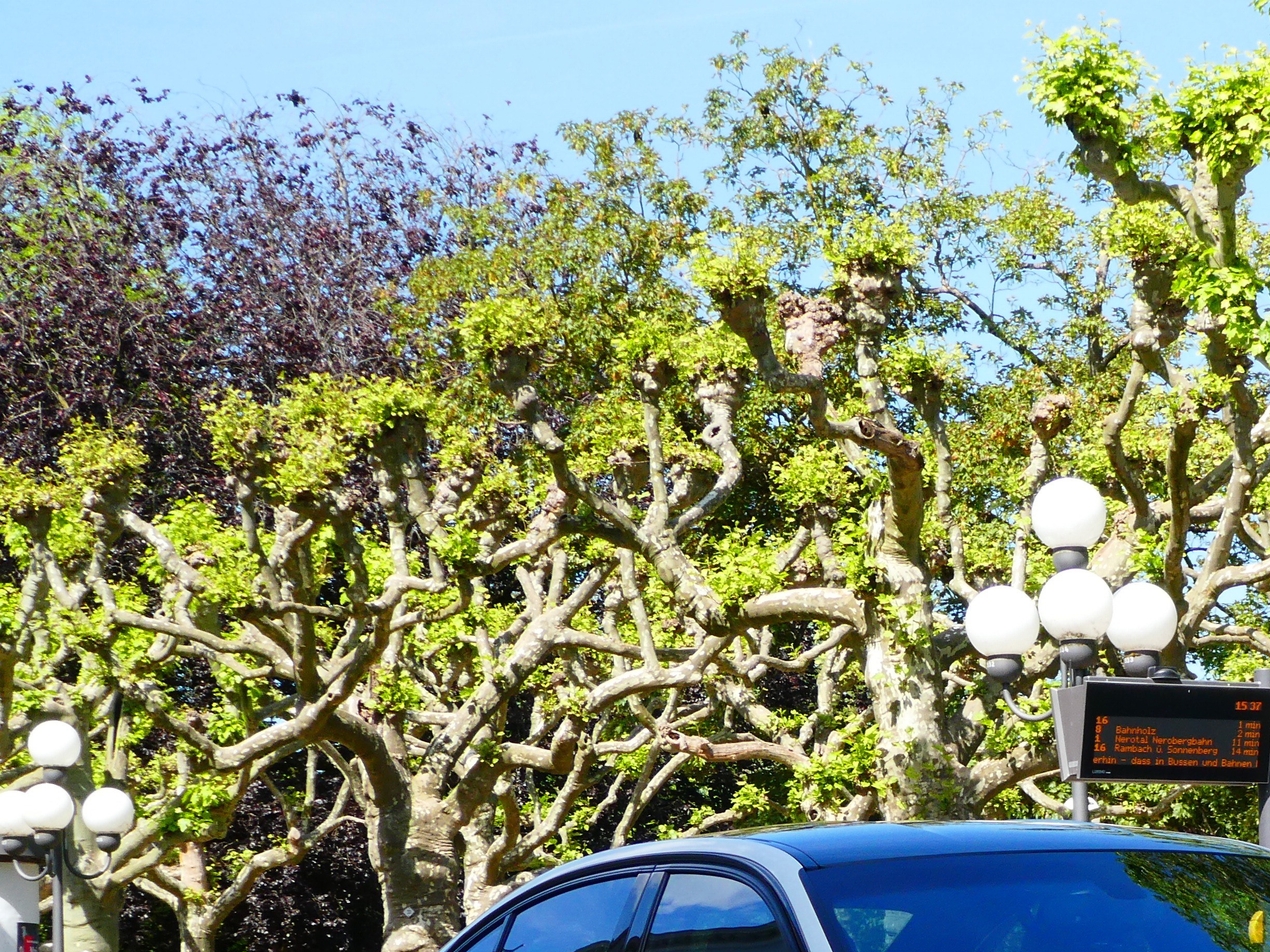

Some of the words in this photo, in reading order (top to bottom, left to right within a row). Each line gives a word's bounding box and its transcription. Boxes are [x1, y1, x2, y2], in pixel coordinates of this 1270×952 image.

[1096, 716, 1109, 725] 16
[1238, 721, 1243, 729] 1
[1245, 721, 1261, 729] min
[1095, 725, 1102, 733] 8
[1115, 725, 1157, 735] Bahnholz
[1237, 730, 1243, 738] 2
[1244, 730, 1260, 738] min
[1094, 734, 1101, 743] 1
[1114, 735, 1149, 744] Nerotal
[1152, 736, 1213, 747] Nerobergbahn
[1232, 738, 1241, 747] 11
[1243, 739, 1260, 747] min
[1093, 743, 1106, 752] 16
[1114, 744, 1152, 753] Rambach
[1167, 746, 1218, 756] Sonnenberg
[1231, 747, 1241, 756] 14
[1243, 748, 1259, 756] min
[1093, 755, 1117, 765] erhin
[1130, 757, 1151, 765] dass
[1154, 757, 1165, 766] in
[1168, 757, 1198, 766] Bussen
[1201, 759, 1218, 767] und
[1221, 758, 1252, 768] Bahnen
